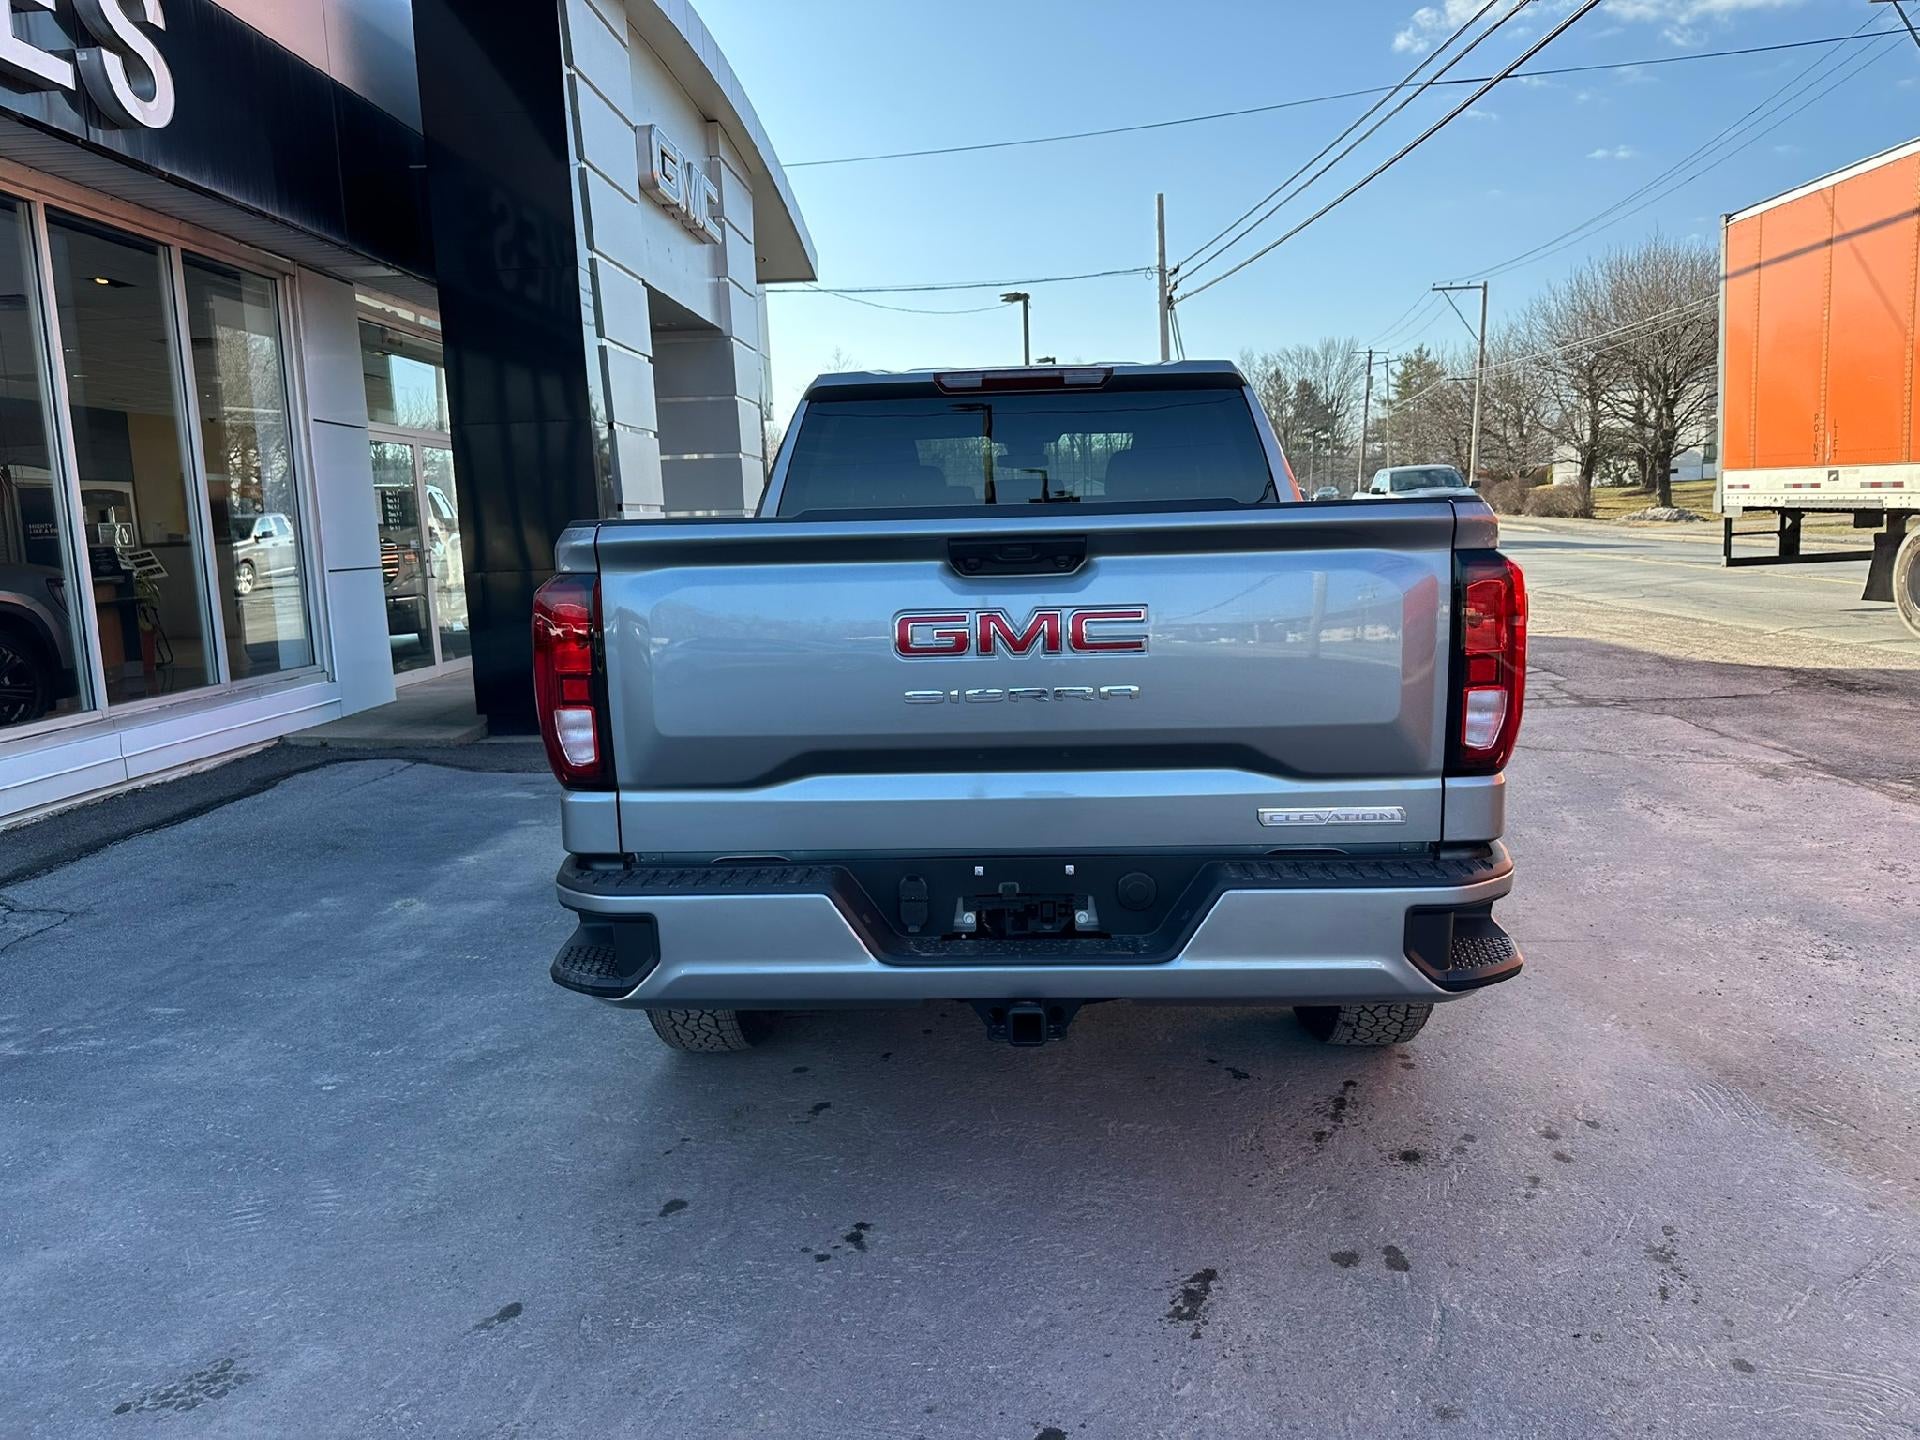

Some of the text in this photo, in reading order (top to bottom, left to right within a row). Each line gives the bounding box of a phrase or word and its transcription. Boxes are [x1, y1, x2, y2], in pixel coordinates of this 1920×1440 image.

[650, 125, 722, 245] GMC
[893, 606, 1148, 658] GMC
[904, 683, 1140, 704] SIERRA
[1267, 811, 1396, 823] ELEVATION
